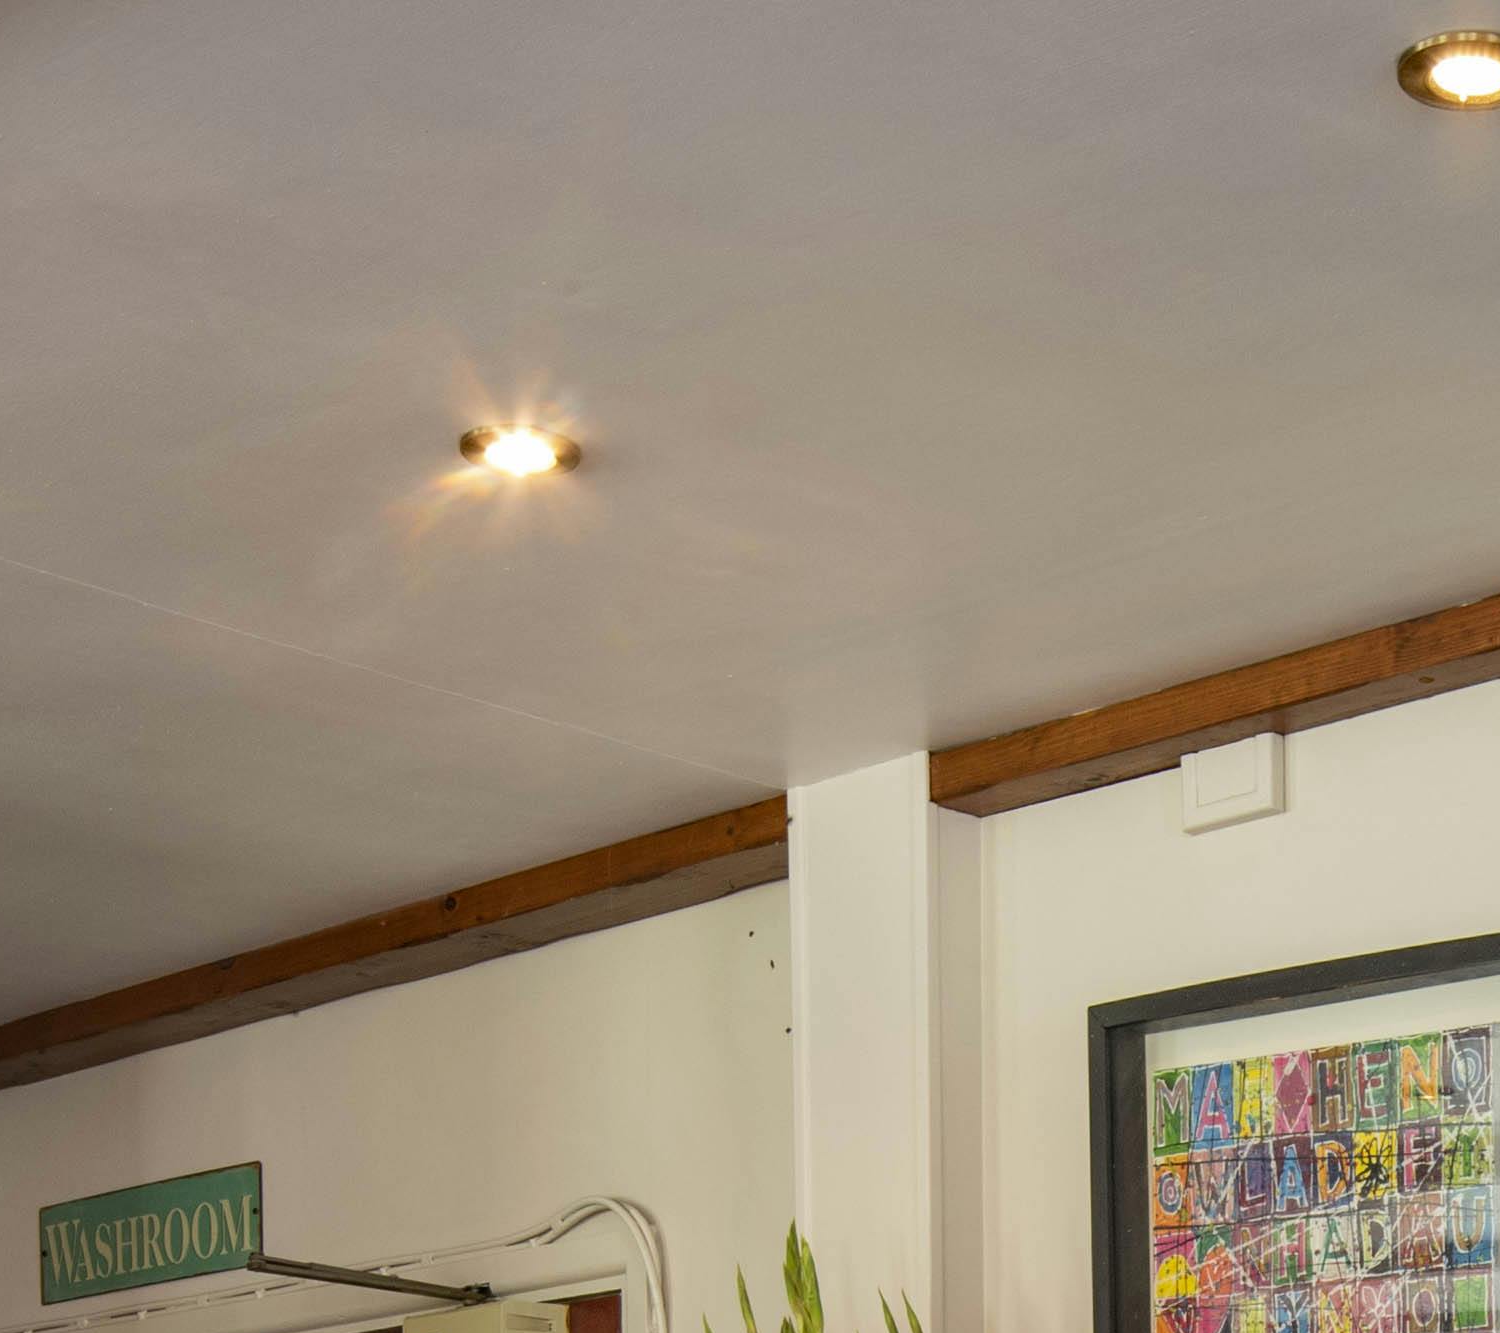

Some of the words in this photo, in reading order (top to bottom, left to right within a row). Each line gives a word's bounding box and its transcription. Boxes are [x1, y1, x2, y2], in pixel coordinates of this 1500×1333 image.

[1316, 1044, 1438, 1128] HEN
[1190, 1140, 1351, 1221] WLAD
[45, 1195, 254, 1285] WASHROOM
